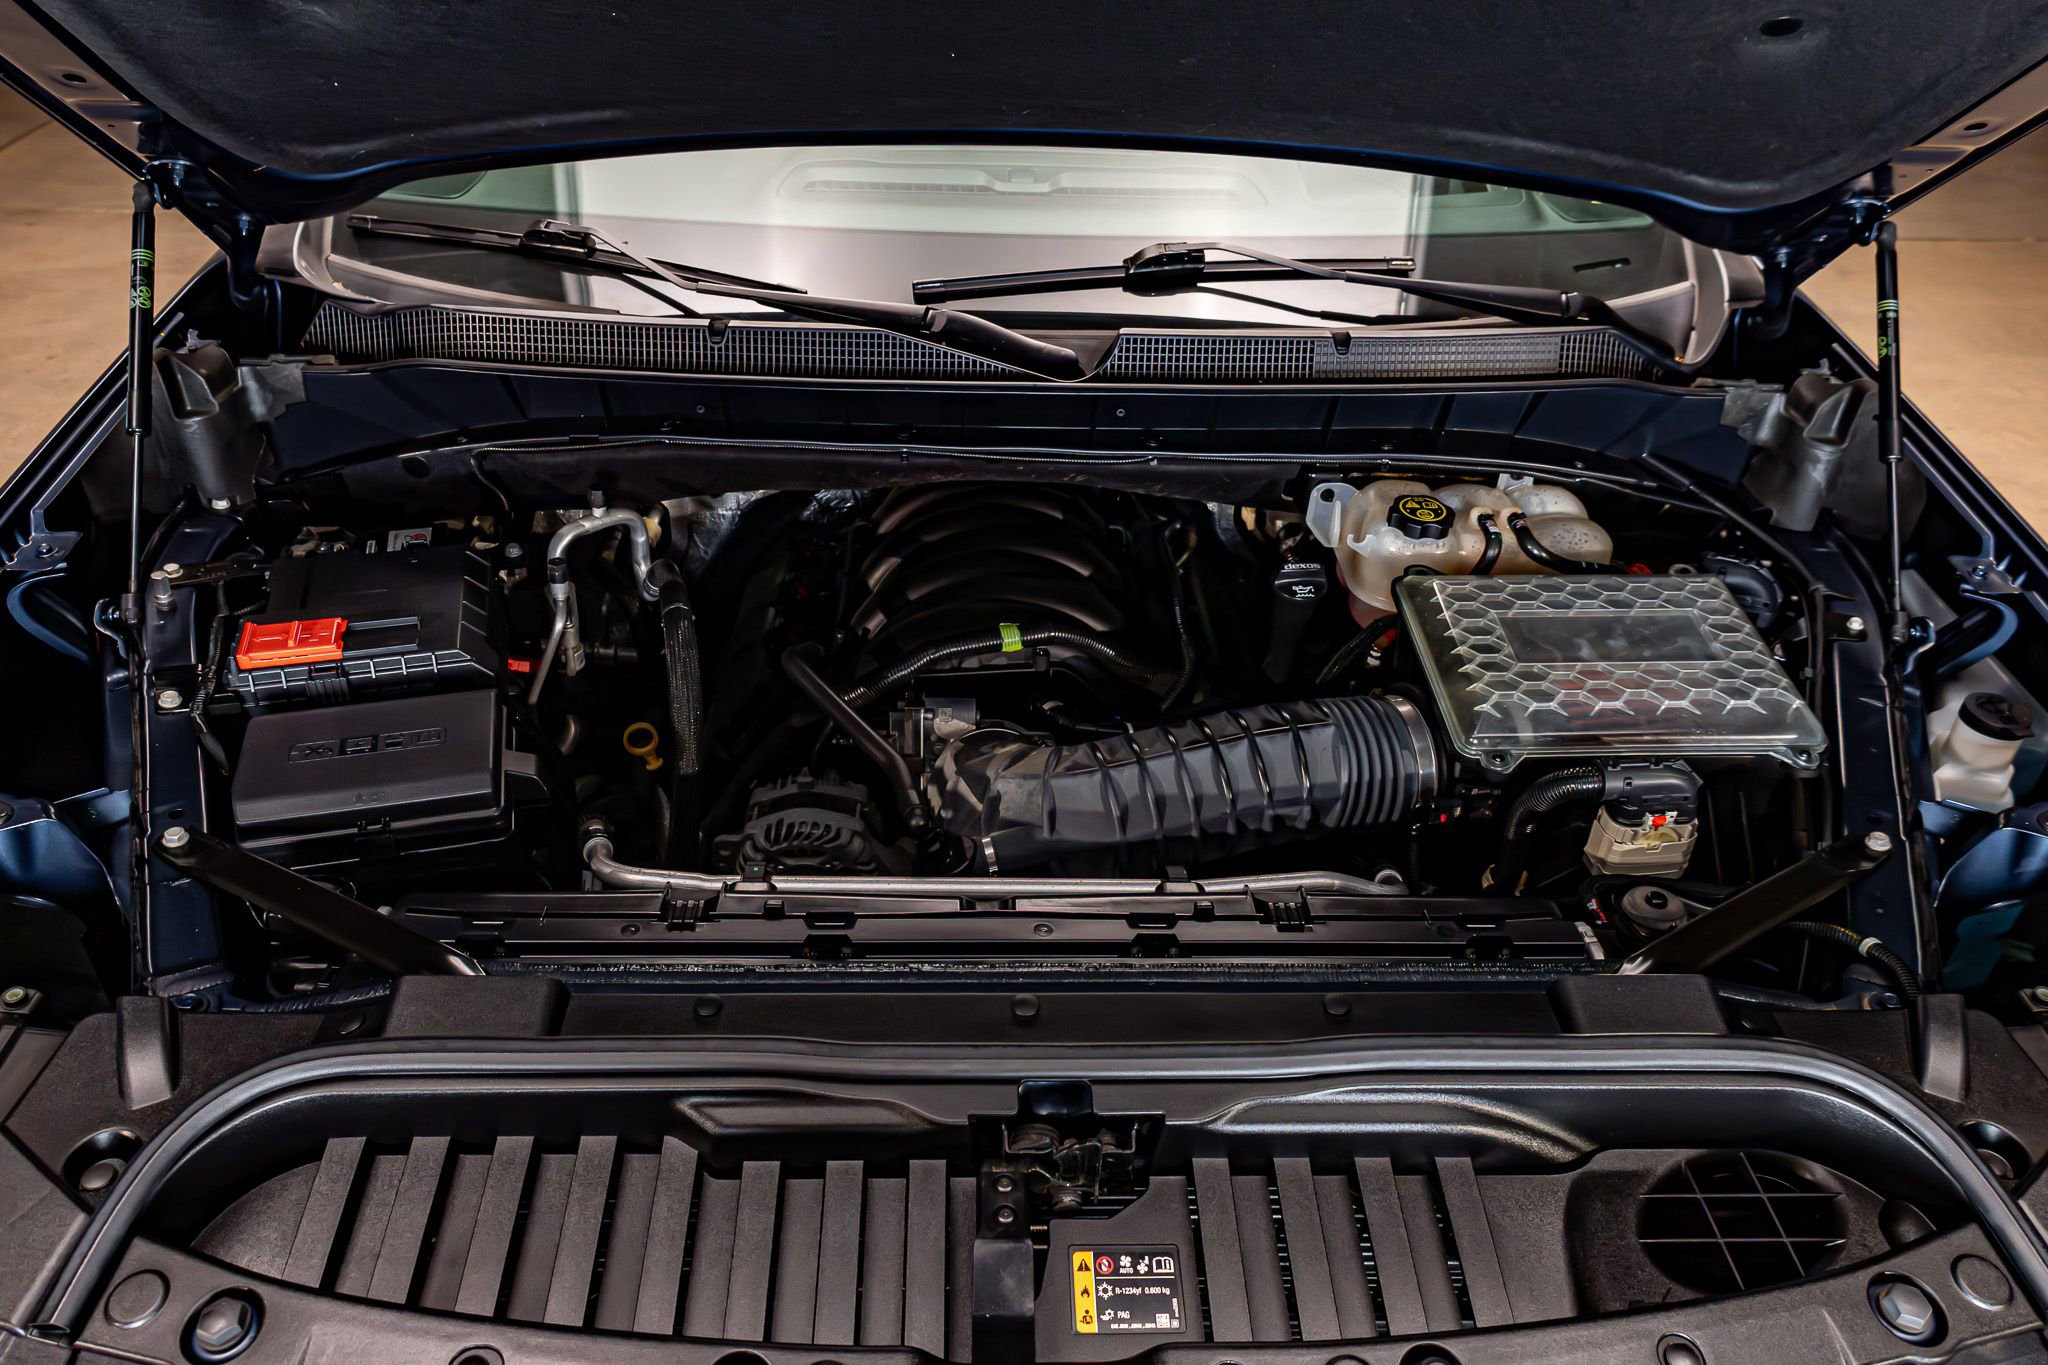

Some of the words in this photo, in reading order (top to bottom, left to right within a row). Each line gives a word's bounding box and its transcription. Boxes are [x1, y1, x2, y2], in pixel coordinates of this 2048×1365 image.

[1115, 1287, 1142, 1295] R-1234yf
[1162, 1287, 1170, 1295] kg
[1117, 1311, 1130, 1319] PAG
